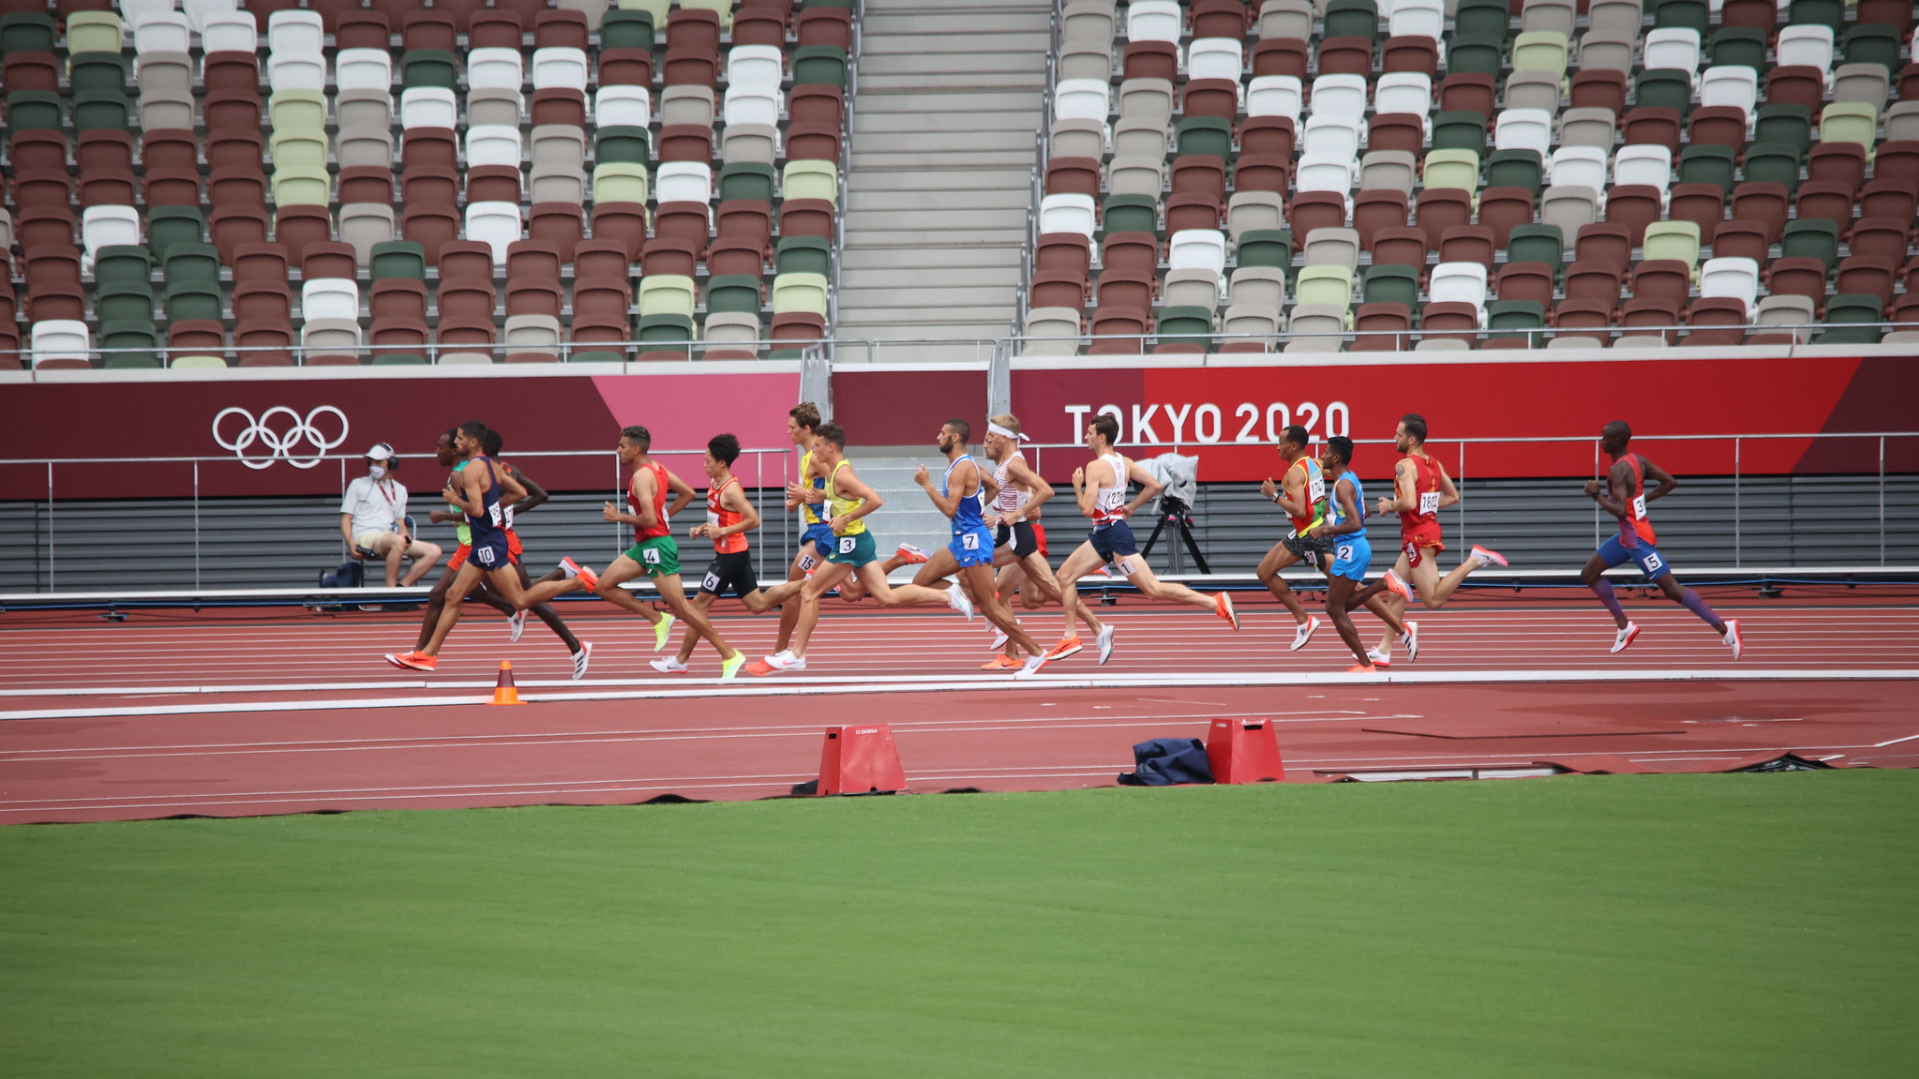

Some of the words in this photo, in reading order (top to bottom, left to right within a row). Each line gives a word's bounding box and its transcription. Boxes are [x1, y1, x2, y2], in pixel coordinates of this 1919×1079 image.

[1235, 401, 1350, 442] 2020
[843, 539, 852, 551] 3
[966, 535, 974, 548] 7
[480, 548, 492, 562] 10
[647, 550, 656, 562] 4
[1340, 547, 1349, 560] 2
[801, 556, 814, 570] 15
[1121, 563, 1131, 574] 1
[1648, 556, 1659, 569] 5
[705, 575, 714, 588] 6
